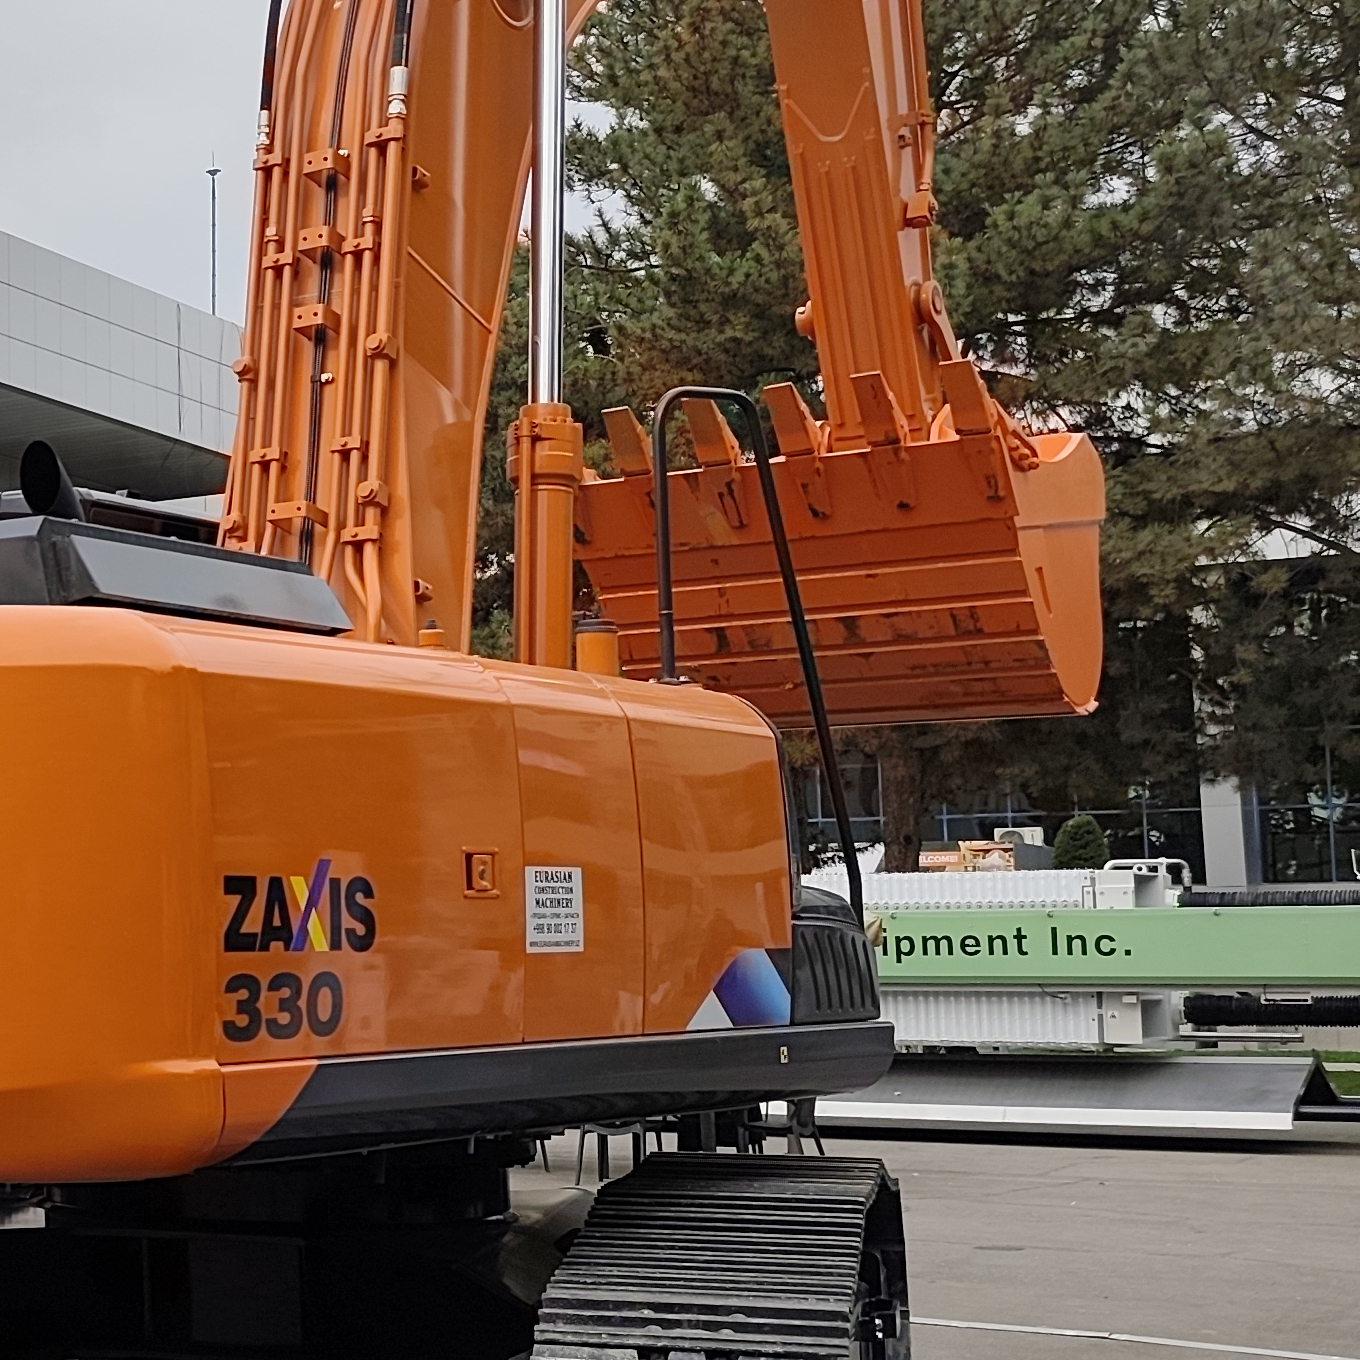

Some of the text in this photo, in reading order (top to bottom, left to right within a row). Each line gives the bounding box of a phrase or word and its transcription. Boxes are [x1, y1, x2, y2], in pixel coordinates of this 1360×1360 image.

[534, 870, 573, 883] EURASIAN
[534, 885, 574, 895] CONSTRUCTION
[223, 858, 376, 953] ZAXIS
[534, 897, 574, 909] MACHINERY
[881, 926, 1132, 964] ipment Inc.
[222, 971, 344, 1043] 330
